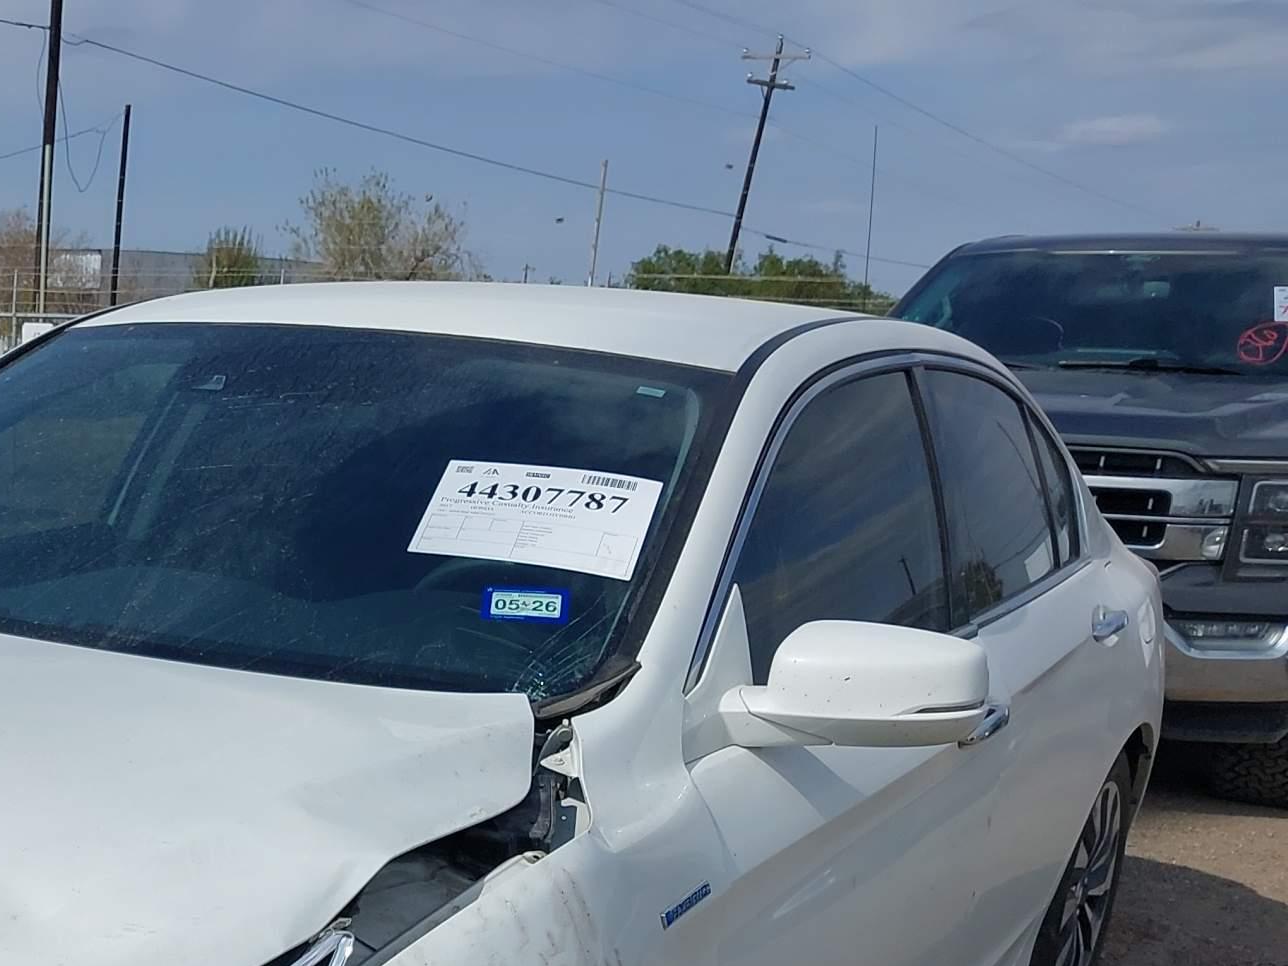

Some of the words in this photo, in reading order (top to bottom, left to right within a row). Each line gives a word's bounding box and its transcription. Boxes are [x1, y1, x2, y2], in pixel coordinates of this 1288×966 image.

[440, 496, 491, 506] Progressive
[492, 499, 529, 510] Casualty
[531, 503, 574, 514] Insurance
[457, 481, 630, 514] 44307787
[494, 598, 520, 611] 05
[532, 600, 558, 613] 26
